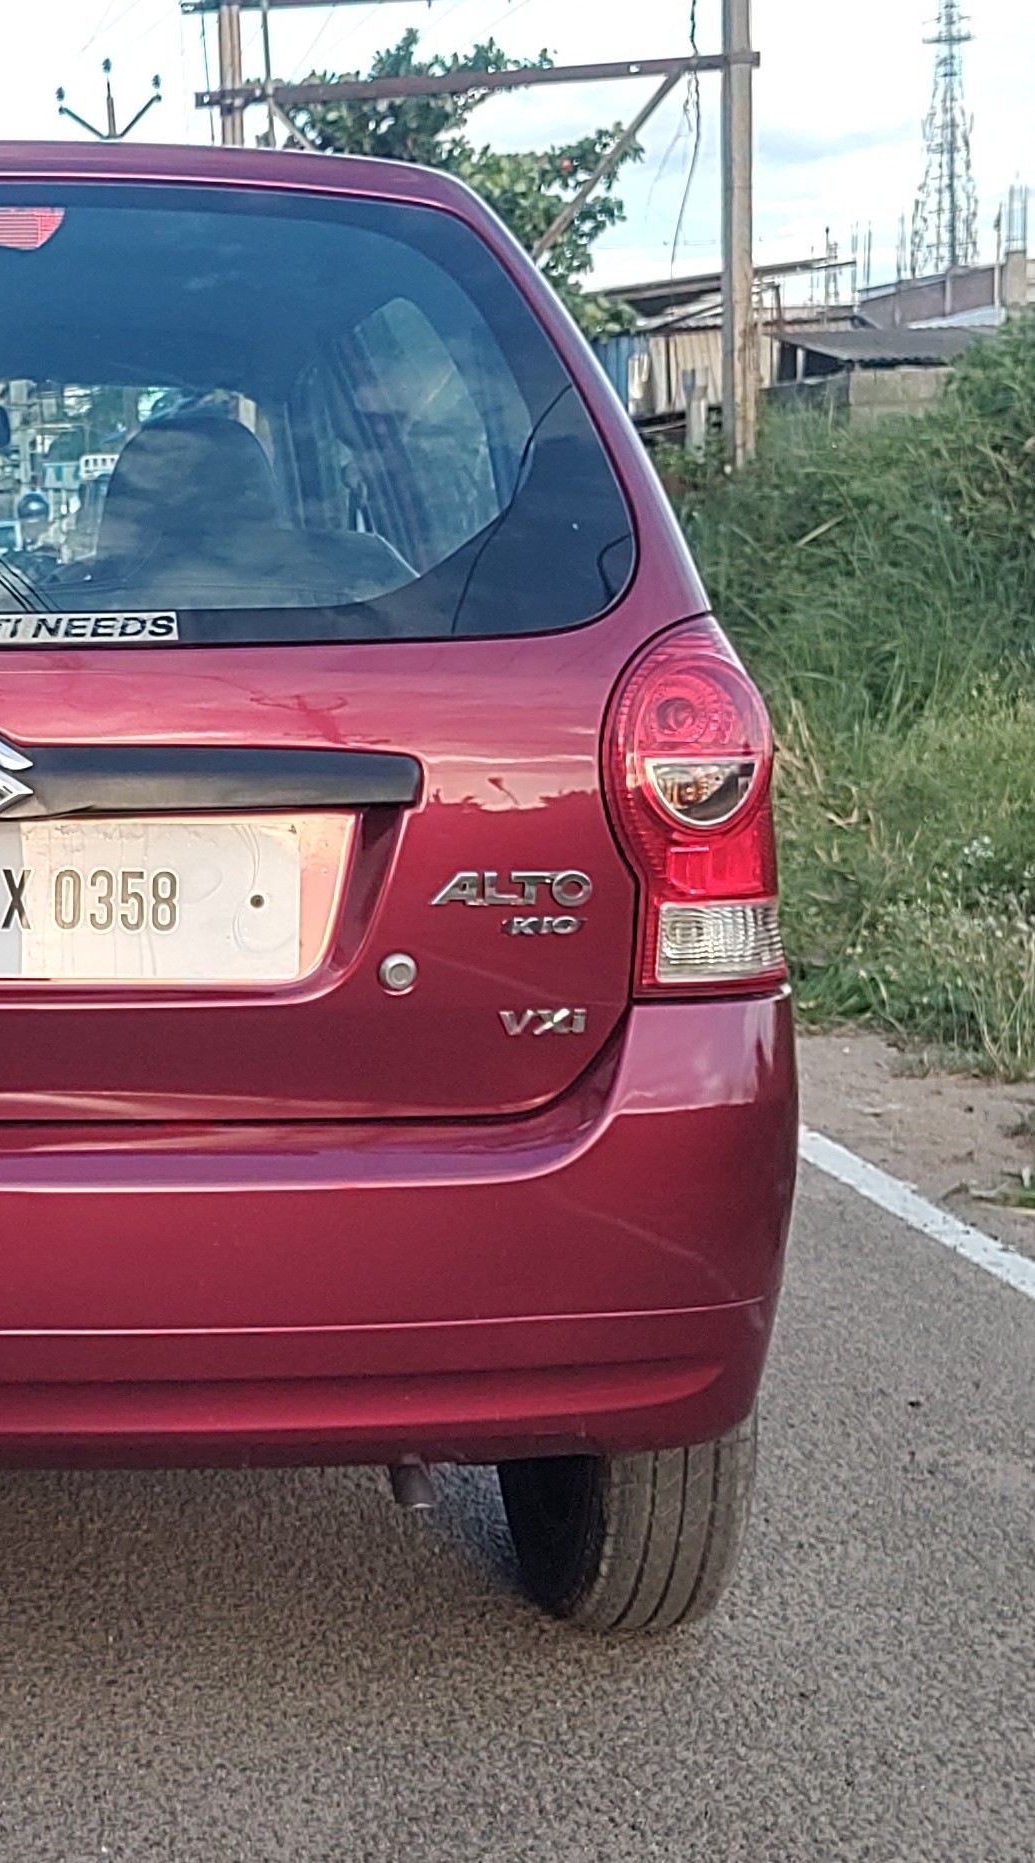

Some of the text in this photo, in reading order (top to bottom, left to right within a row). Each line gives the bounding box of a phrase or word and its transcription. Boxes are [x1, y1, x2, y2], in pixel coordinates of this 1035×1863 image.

[32, 616, 174, 638] NEEDS
[54, 869, 177, 931] 0358
[429, 870, 592, 907] ALTO
